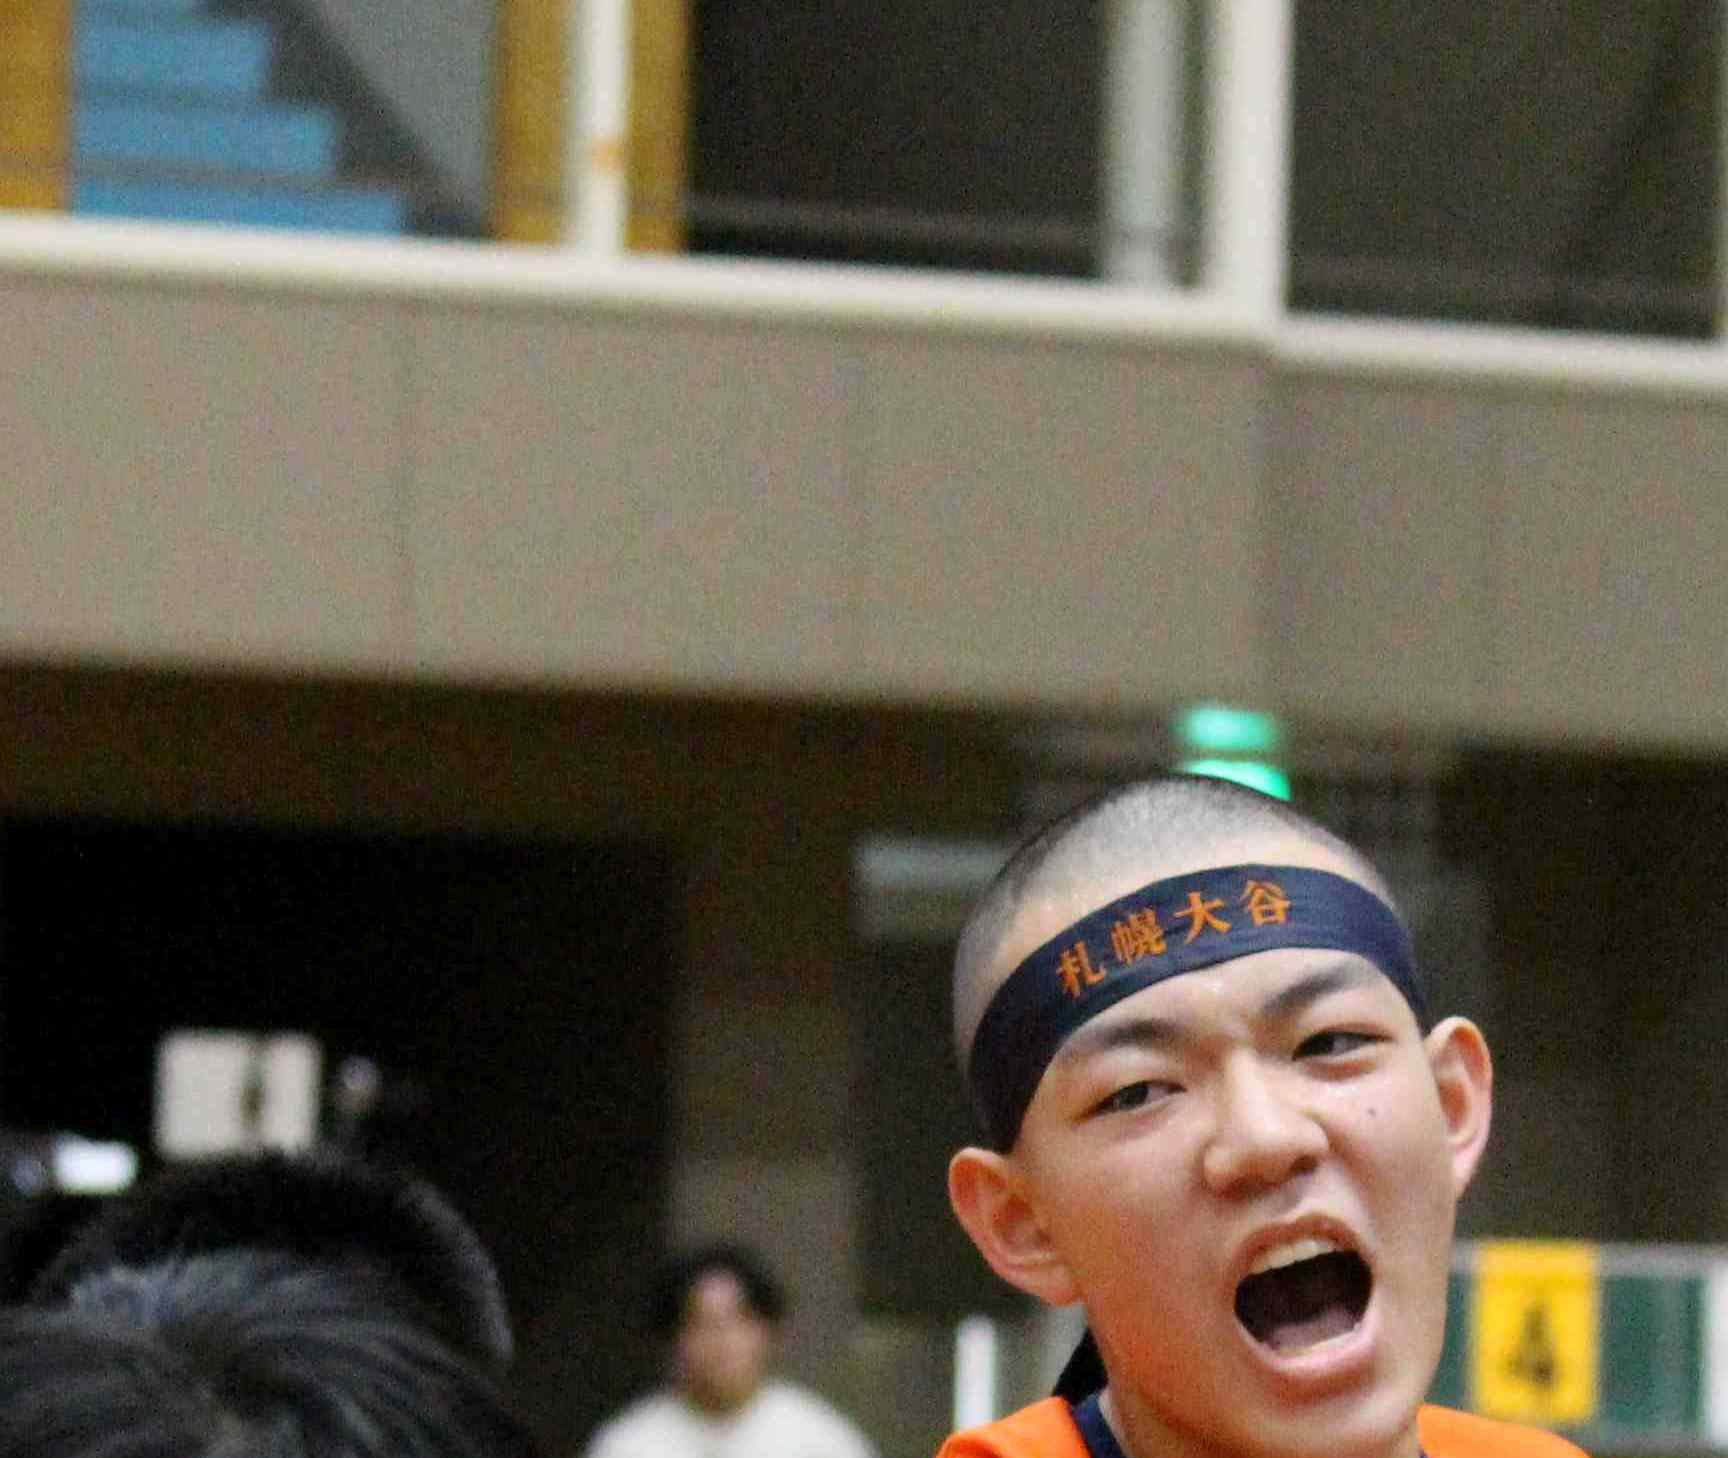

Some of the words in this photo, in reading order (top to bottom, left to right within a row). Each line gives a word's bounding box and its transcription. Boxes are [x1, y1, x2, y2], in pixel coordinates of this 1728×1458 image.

[1056, 880, 1292, 998] 札幌大谷
[1502, 1297, 1558, 1390] 4
